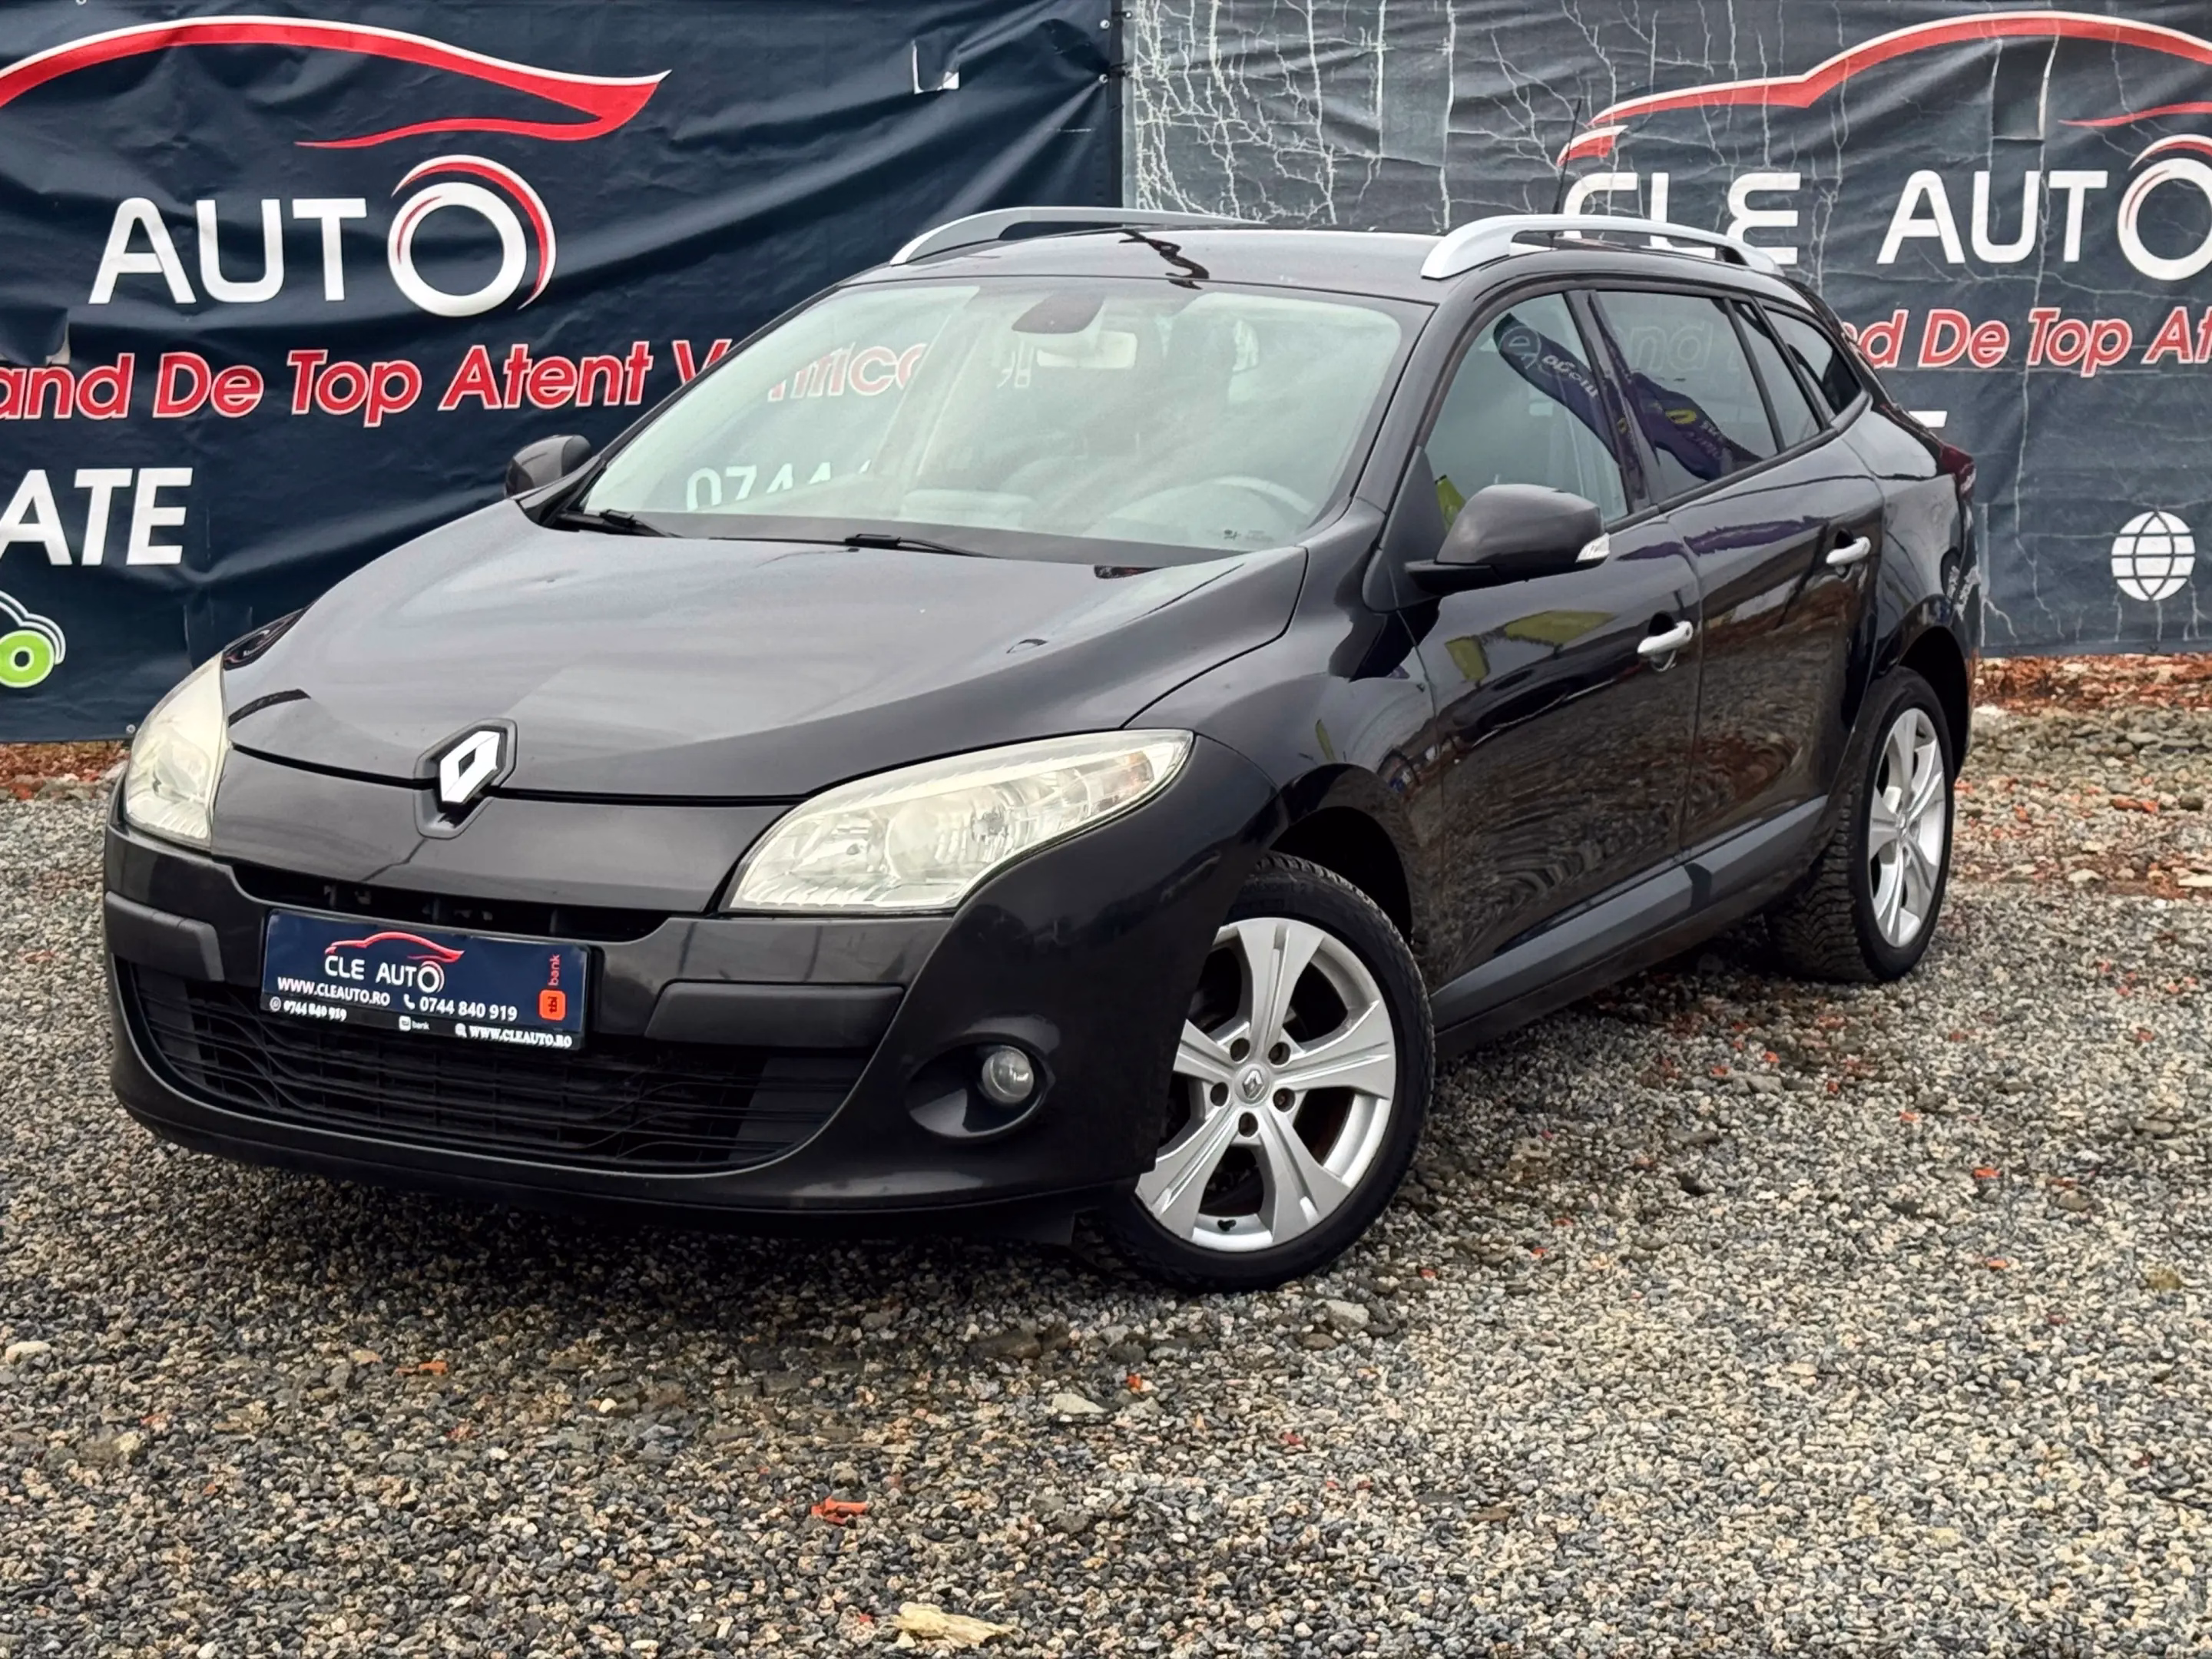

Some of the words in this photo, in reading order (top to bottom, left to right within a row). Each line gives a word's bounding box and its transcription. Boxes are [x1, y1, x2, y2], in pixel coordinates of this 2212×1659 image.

[88, 182, 527, 316] AUTO
[1876, 158, 2212, 281] AUTO
[1918, 309, 2010, 369] De
[2027, 307, 2133, 378] Top
[152, 351, 264, 418] De
[286, 349, 422, 428] Top
[437, 340, 654, 412] Atent
[0, 468, 193, 566] ATE
[277, 977, 390, 1006] WWW.CLEAUTO.RO
[324, 955, 366, 980] CLE
[376, 962, 439, 993] AUTO
[548, 954, 561, 986] bank
[419, 996, 455, 1015] 0744
[458, 1001, 486, 1018] 840
[488, 1005, 518, 1022] 919
